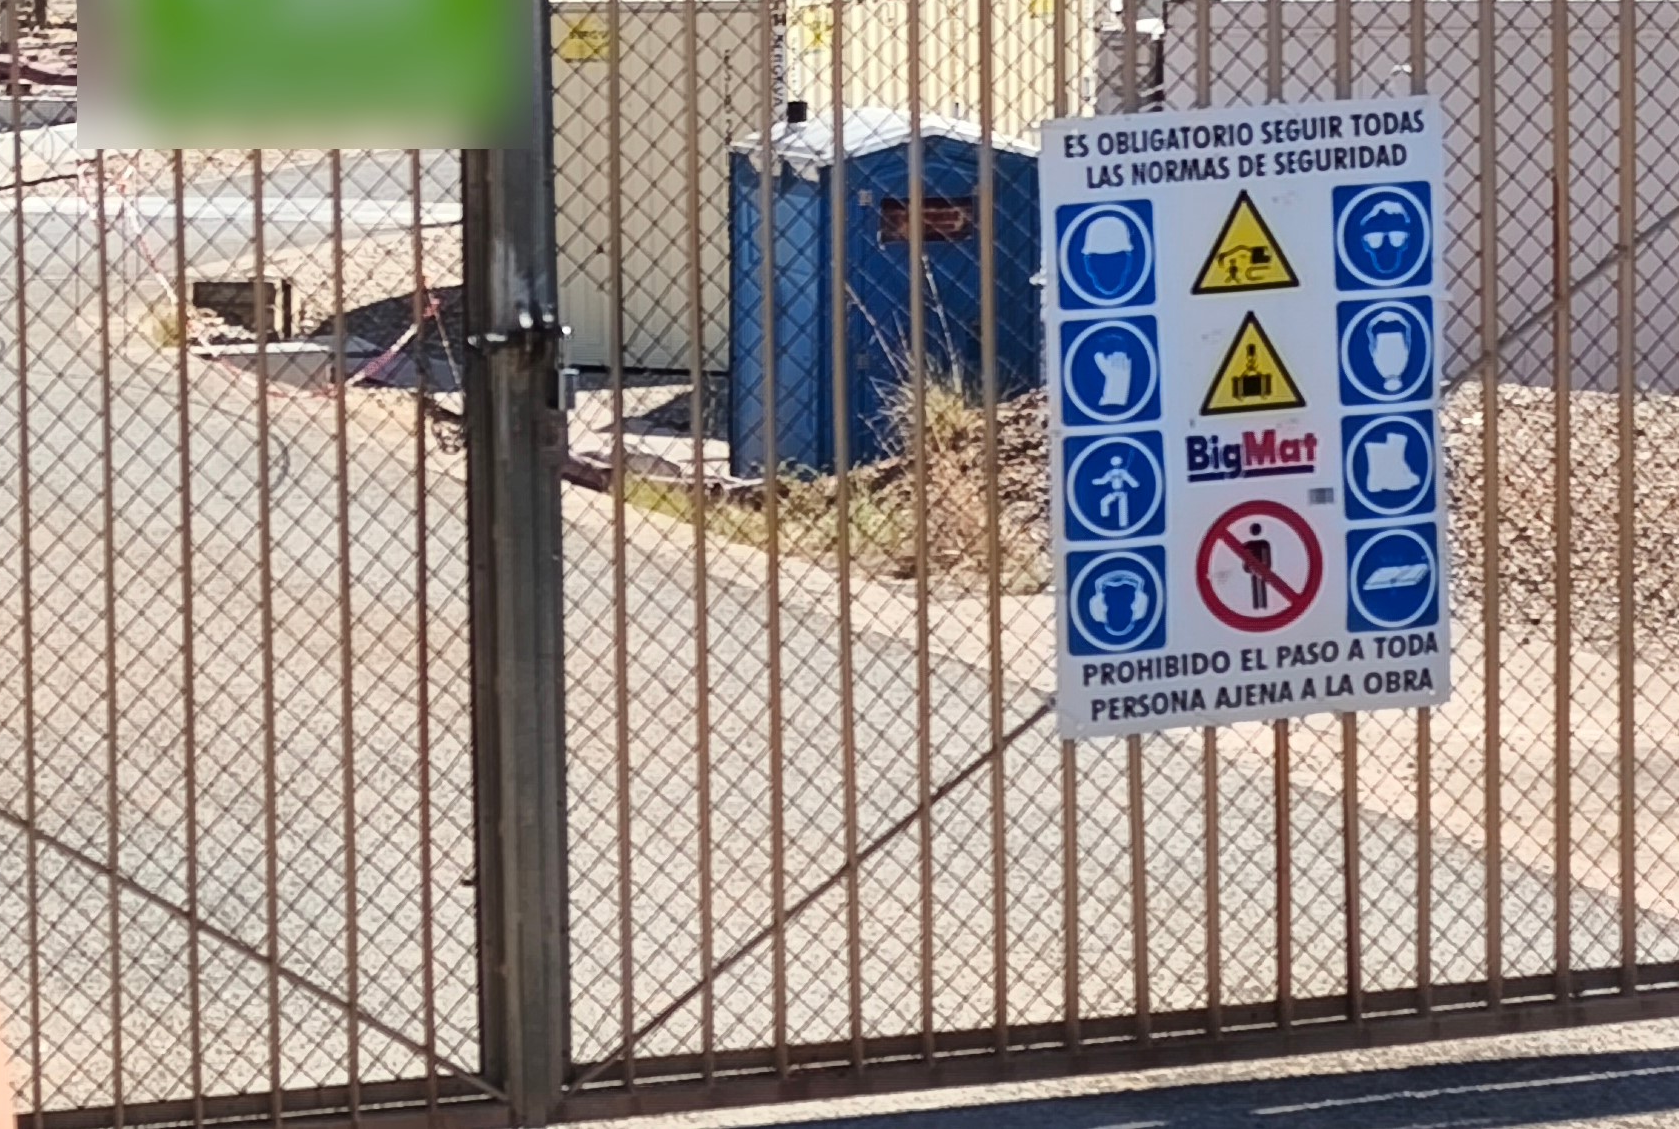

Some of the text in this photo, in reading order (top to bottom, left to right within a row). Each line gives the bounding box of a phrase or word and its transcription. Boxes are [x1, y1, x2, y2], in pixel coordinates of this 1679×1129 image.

[1064, 110, 1425, 158] ES OBLIGATORIO SEGUIR TODAS
[1087, 144, 1407, 188] LAS NORMAS DE SEGURIDAD
[1186, 429, 1317, 479] BigMat
[1082, 632, 1438, 687] PROHIBIDO EL PASO A TODA
[1090, 668, 1433, 721] PERSONA AJENA A LA OBRA
